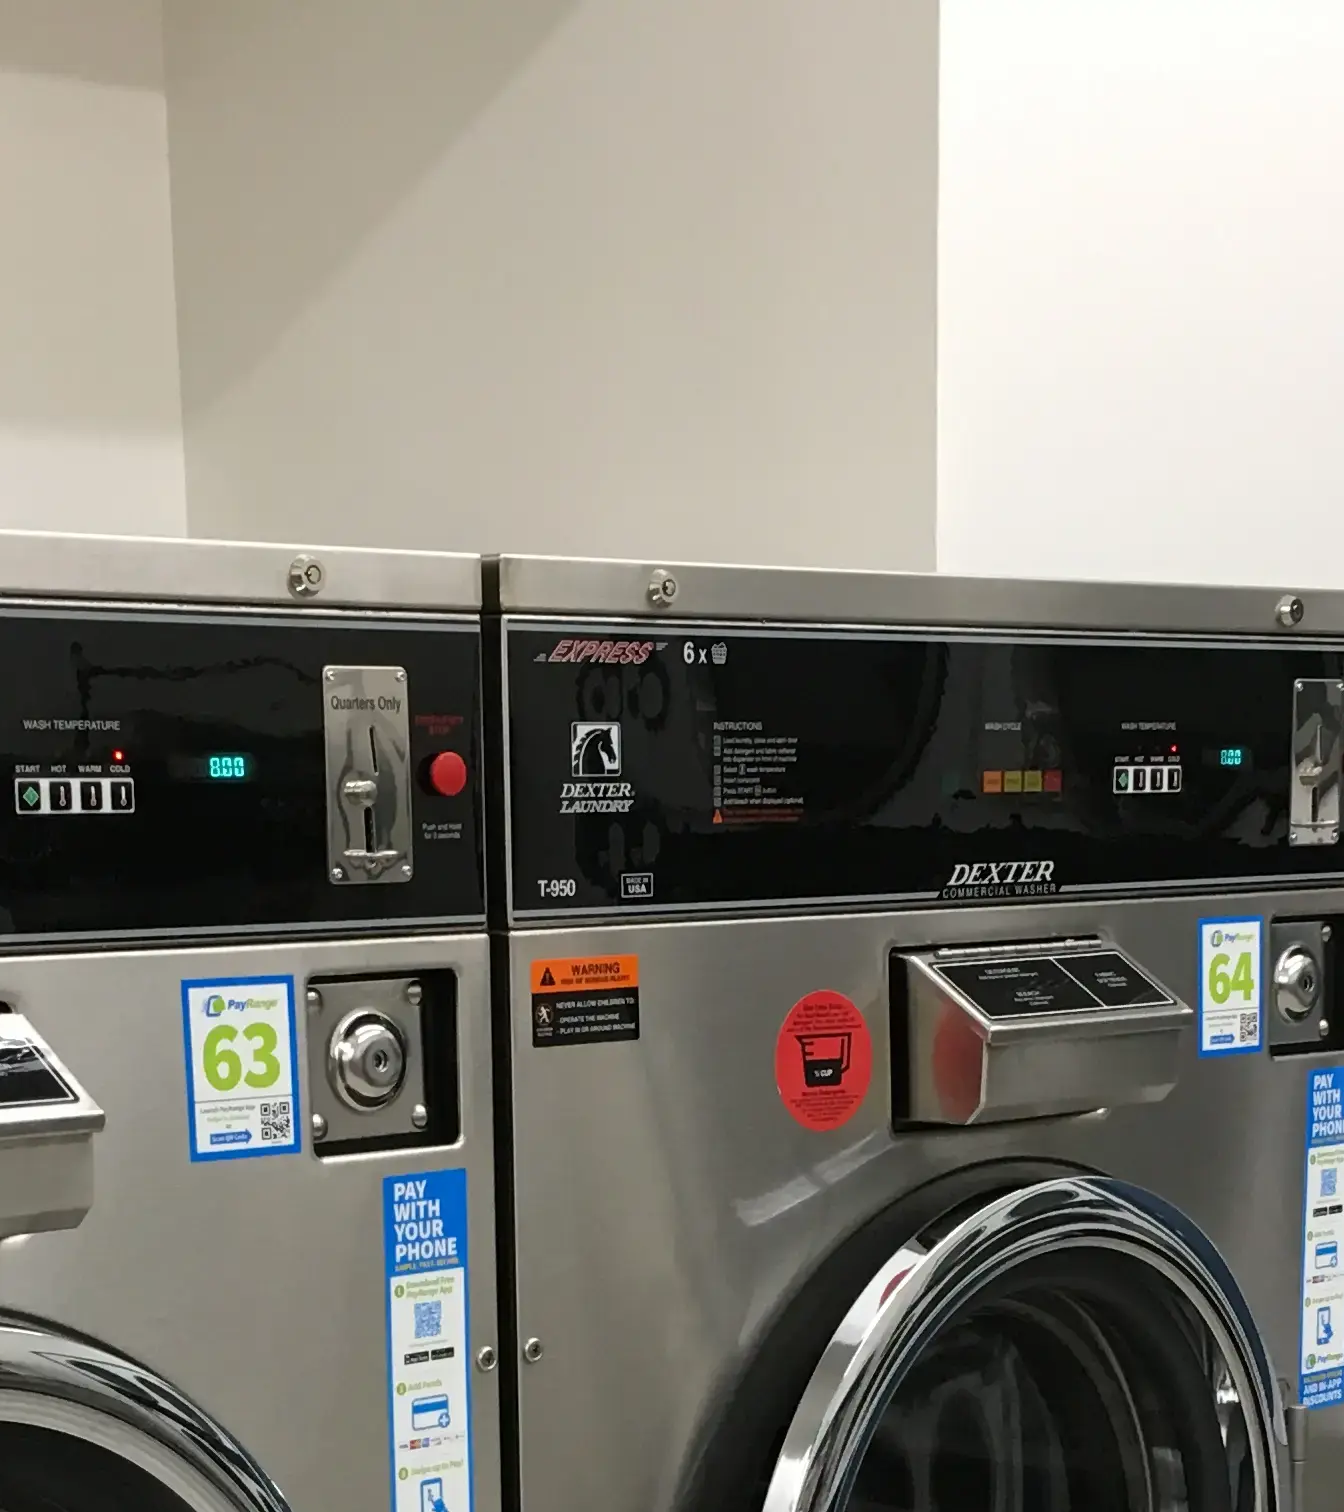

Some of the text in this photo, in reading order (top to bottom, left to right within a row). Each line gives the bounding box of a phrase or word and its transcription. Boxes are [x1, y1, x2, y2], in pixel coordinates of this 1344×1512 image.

[548, 640, 654, 664] EXPRESS
[683, 641, 695, 664] 6
[331, 696, 401, 713] Quarters Only
[23, 719, 120, 730] WASH TEMPERATURE
[15, 765, 130, 773] START HOT WARM COLD
[560, 783, 631, 798] DEXTER
[560, 800, 634, 813] LAUNDRY
[946, 861, 1055, 886] DEXTER
[537, 879, 576, 897] T-950
[628, 884, 647, 893] USA
[943, 883, 1056, 898] COMMERCIAL WASHER
[571, 962, 620, 976] WARNING
[1209, 952, 1254, 1004] 64
[228, 998, 279, 1011] PayRange
[203, 1022, 281, 1091] 63
[821, 1069, 833, 1077] CUP
[1313, 1073, 1333, 1090] PAY
[1313, 1089, 1341, 1106] WITH
[1313, 1105, 1342, 1122] YOUR
[393, 1180, 427, 1202] PAY
[394, 1199, 440, 1223] WITH
[394, 1219, 444, 1242] YOUR
[395, 1238, 457, 1263] PHONE
